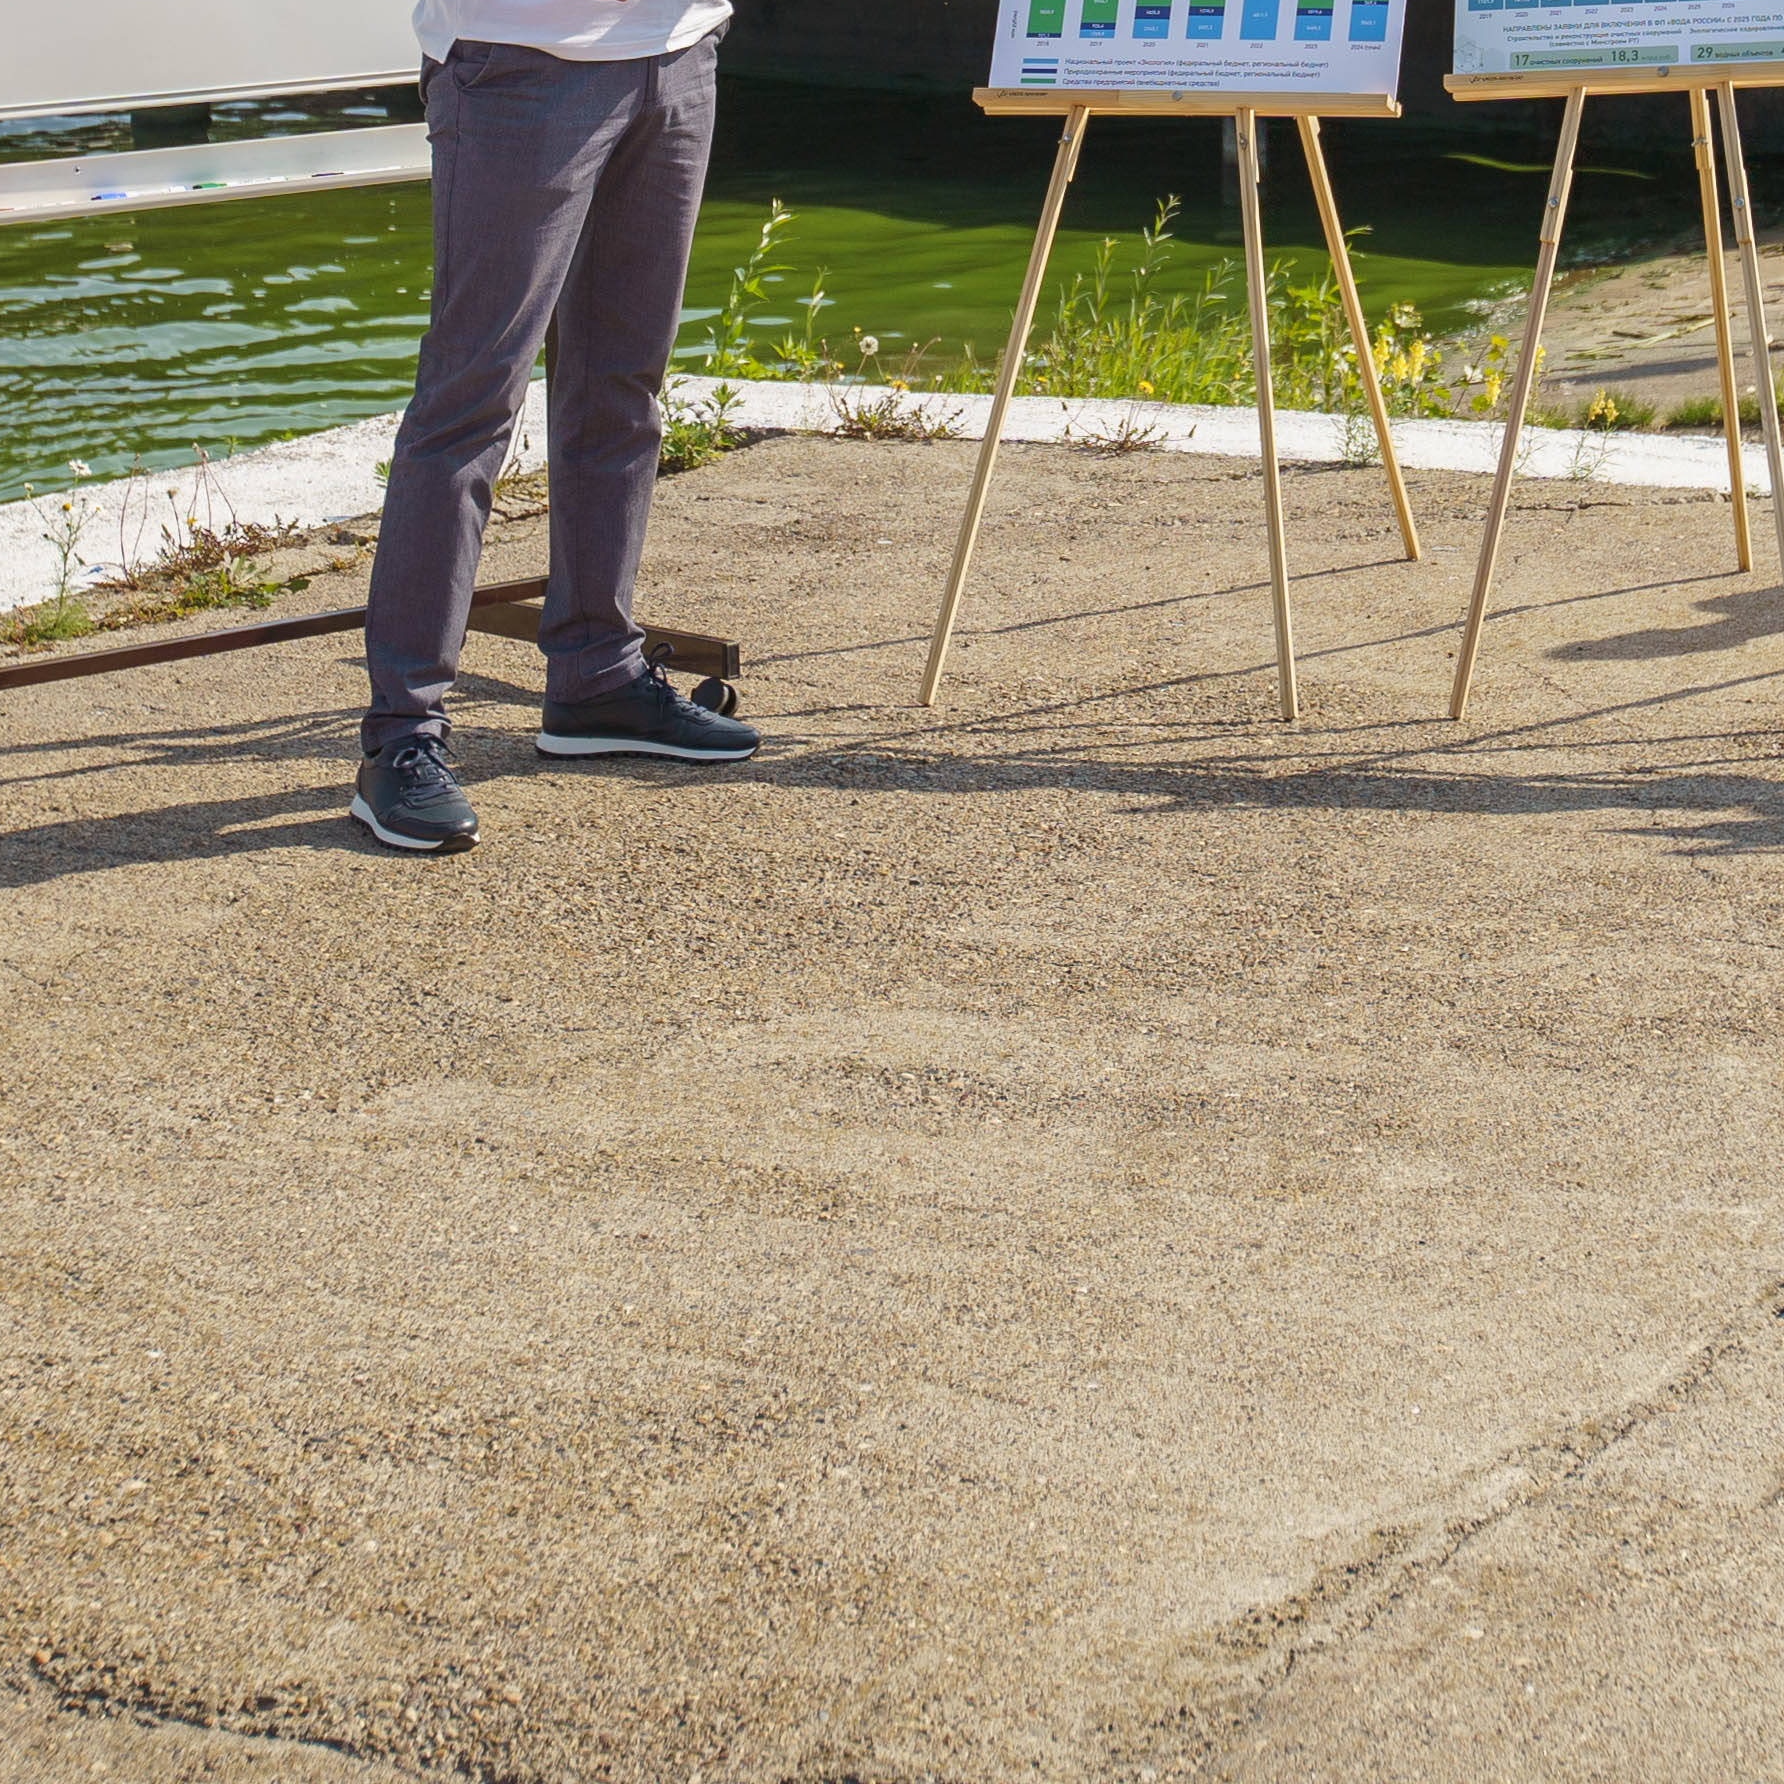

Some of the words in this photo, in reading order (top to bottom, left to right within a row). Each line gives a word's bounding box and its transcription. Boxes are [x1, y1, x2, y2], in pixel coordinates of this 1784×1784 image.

[1503, 24, 1552, 33] НАПРАВЛЕНЫ
[1553, 23, 1582, 31] ЗАЯВКИ
[1583, 22, 1599, 30] ДЛЯ
[1600, 20, 1646, 29] ВКЛЮЧЕНИЯ
[1751, 15, 1771, 23] ГОДА
[1611, 50, 1639, 63] 18,3
[1696, 46, 1713, 59] 29
[1515, 54, 1530, 66] 17
